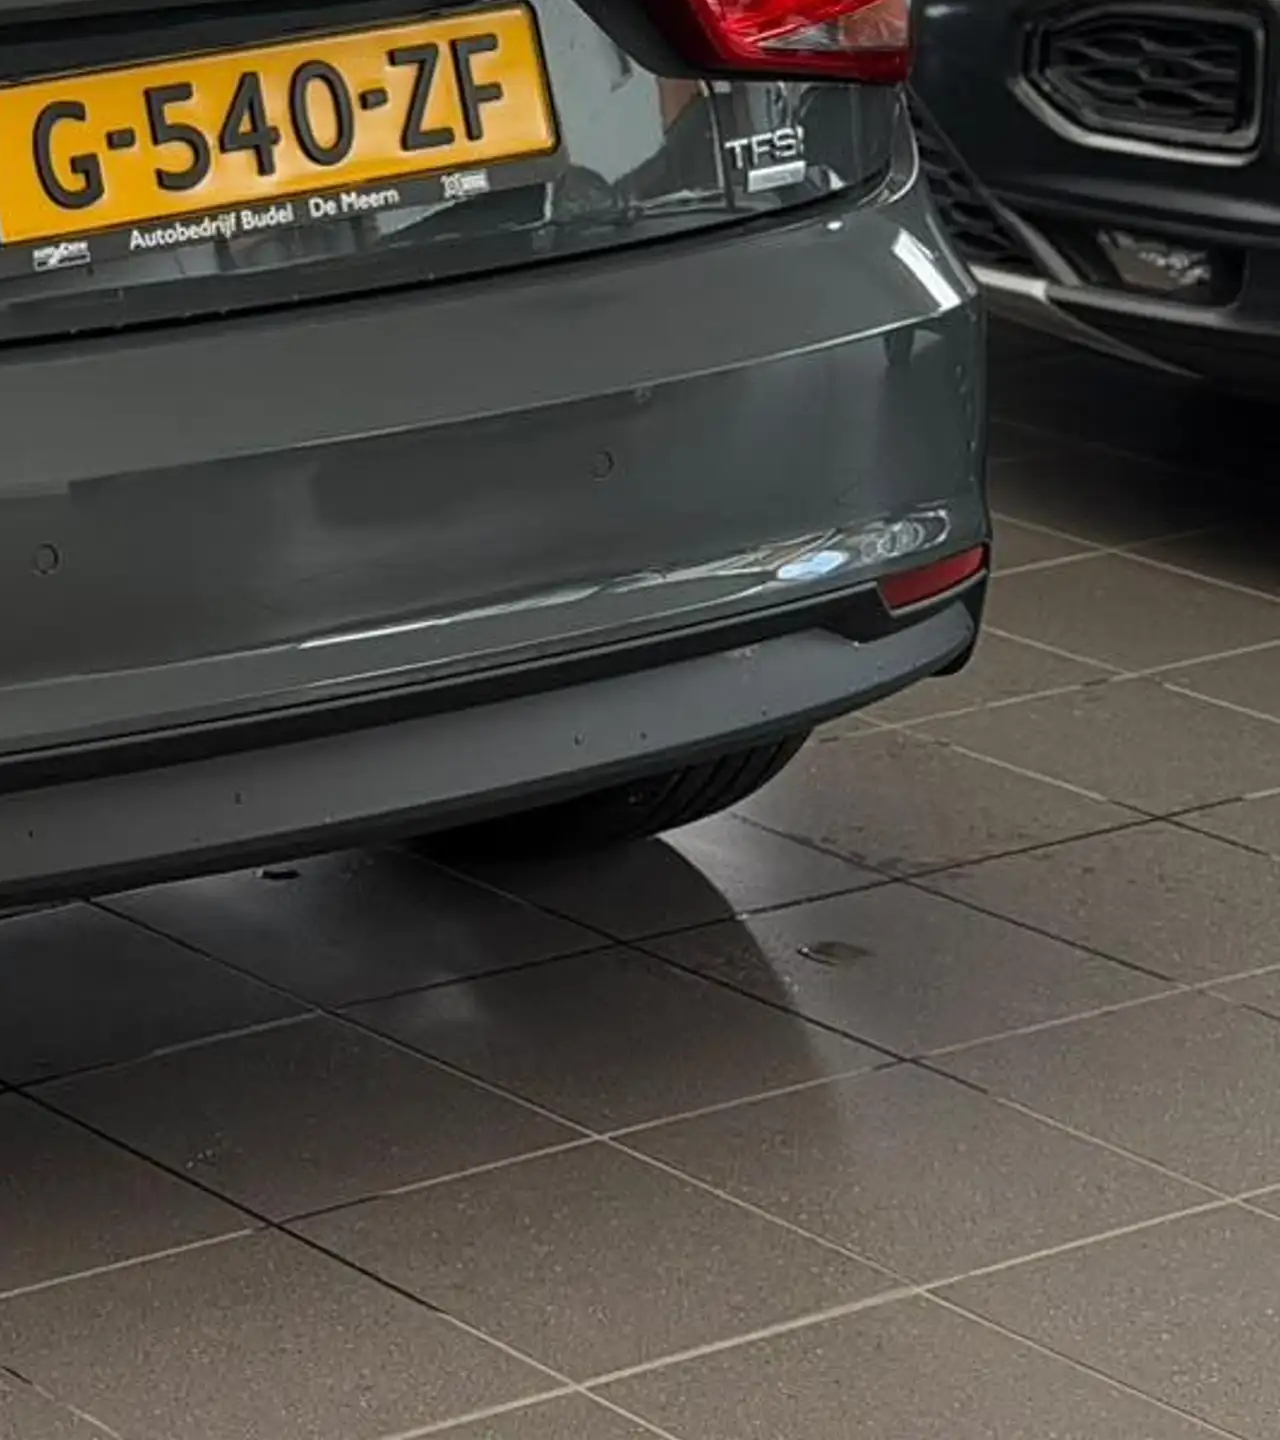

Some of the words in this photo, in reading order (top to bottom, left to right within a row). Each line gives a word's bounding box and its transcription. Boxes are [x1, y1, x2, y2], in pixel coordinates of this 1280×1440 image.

[31, 32, 504, 211] G-540-ZF
[128, 213, 239, 251] Autobedrijf
[240, 203, 294, 231] Budel
[307, 196, 337, 219] De
[340, 187, 400, 213] Meern
